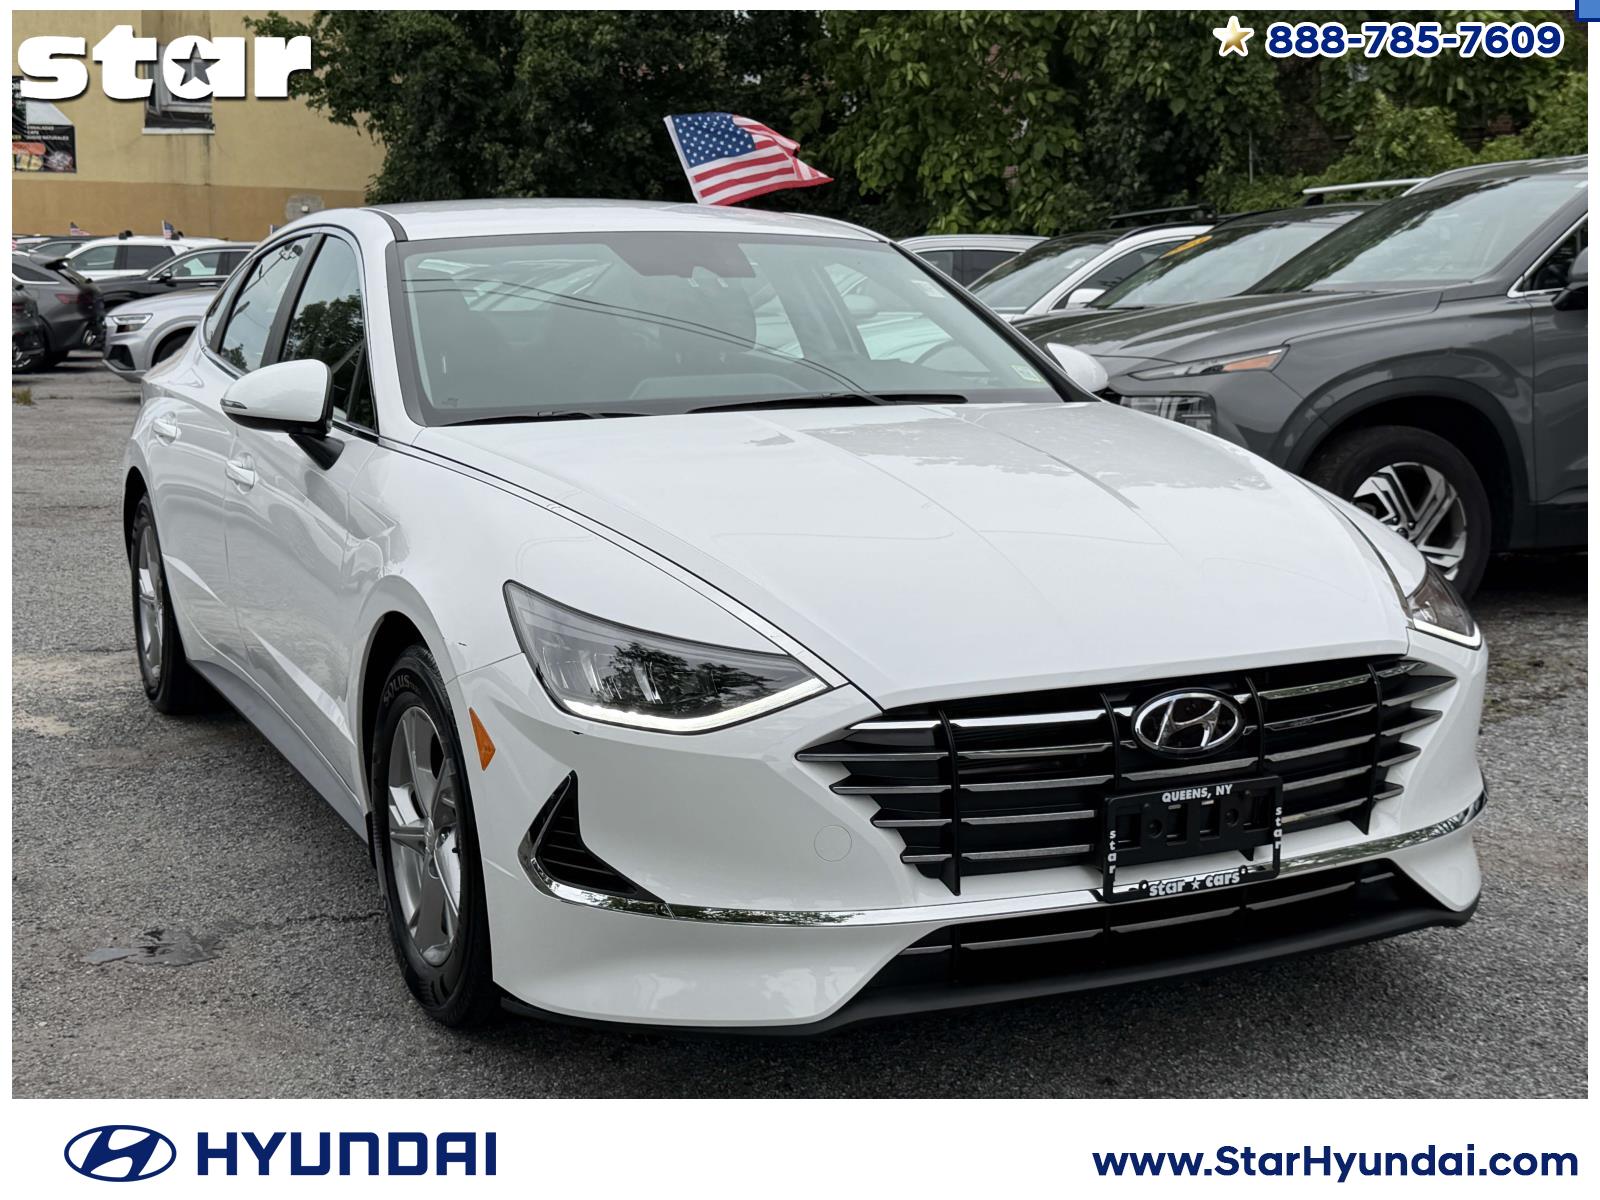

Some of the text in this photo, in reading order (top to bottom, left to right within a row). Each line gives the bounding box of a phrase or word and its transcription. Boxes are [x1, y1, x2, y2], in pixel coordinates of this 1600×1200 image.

[1162, 784, 1232, 803] QUEENS, NY
[1149, 872, 1240, 897] star cars
